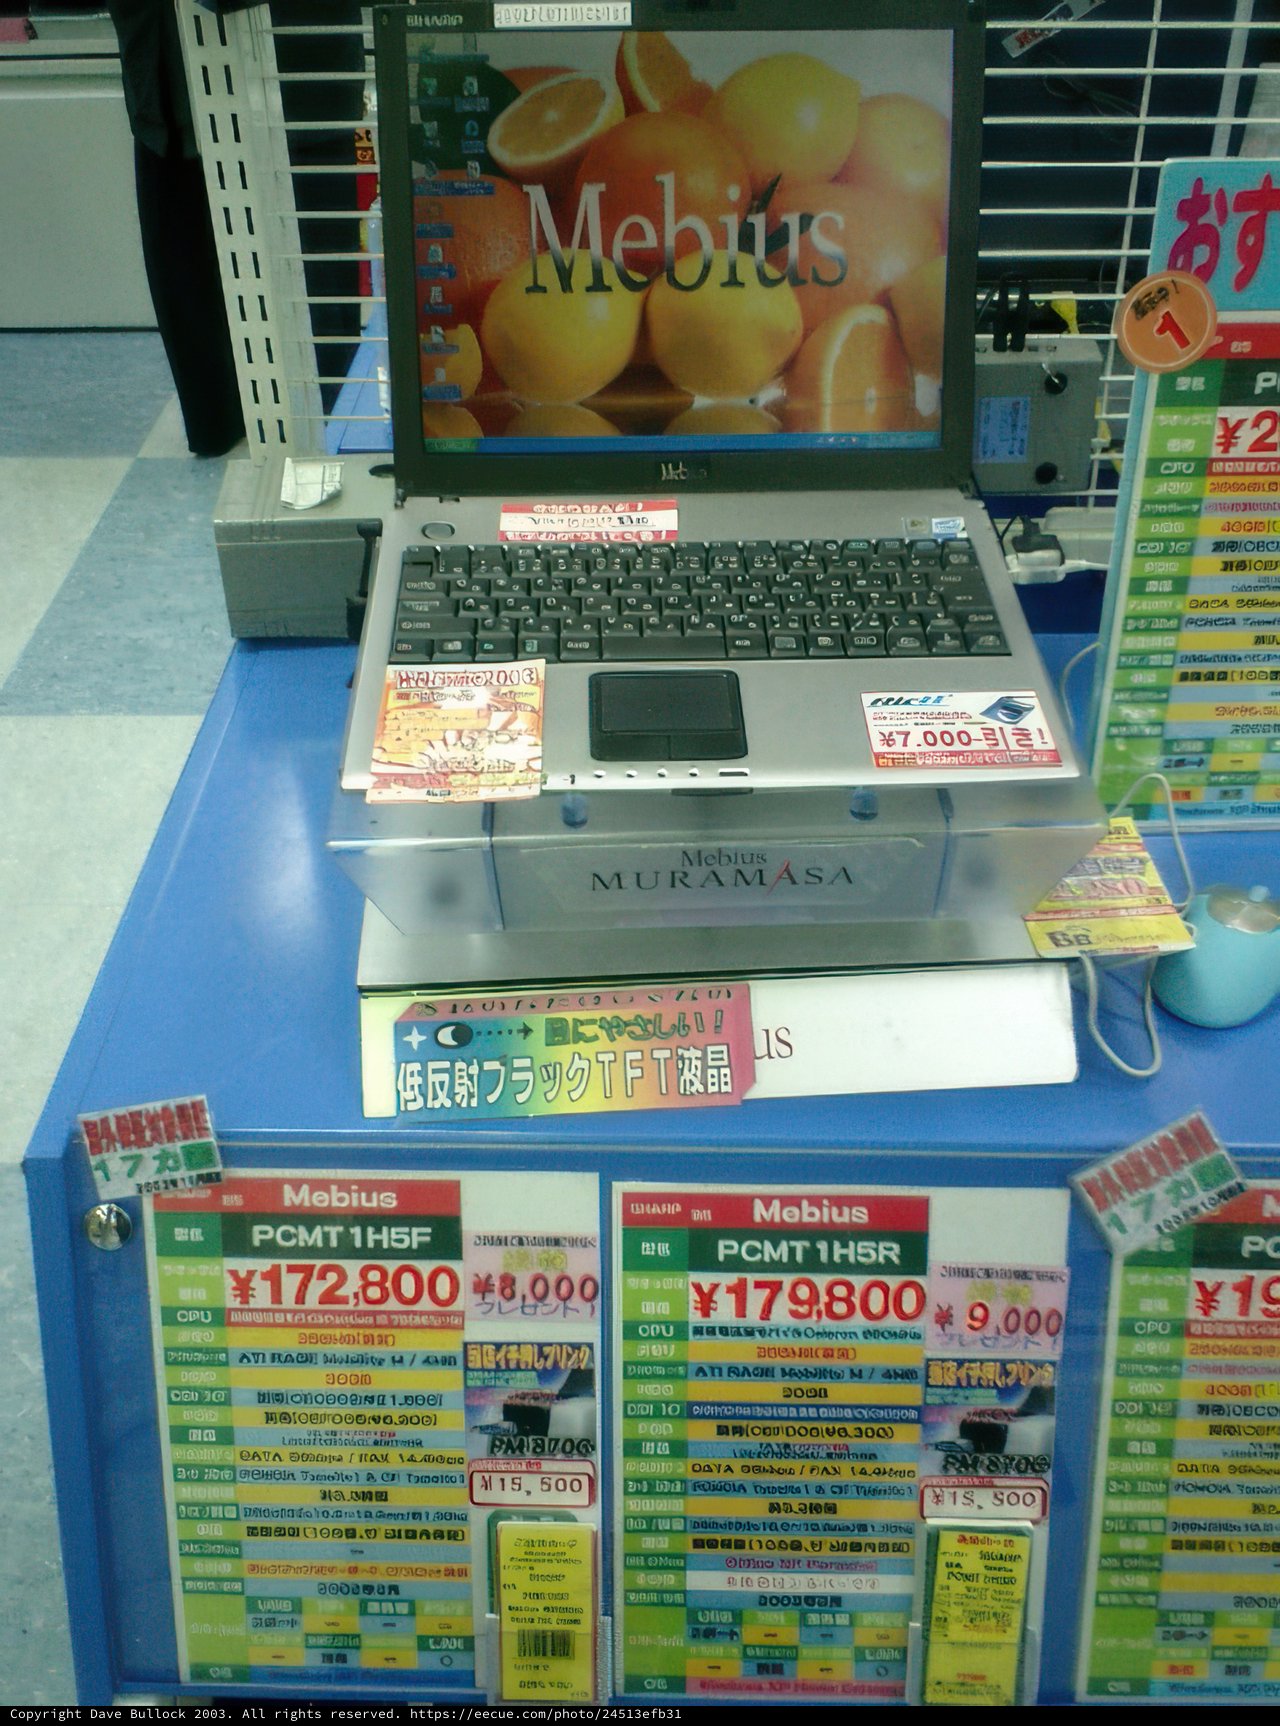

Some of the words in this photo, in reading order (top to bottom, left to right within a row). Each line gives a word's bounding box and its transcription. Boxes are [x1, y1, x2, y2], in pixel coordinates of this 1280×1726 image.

[523, 172, 848, 295] Mebius
[1154, 310, 1191, 350] 1
[681, 849, 768, 868] Mebius
[591, 861, 854, 893] MURAMASA
[283, 1184, 399, 1209] Mebius
[752, 1198, 869, 1223] Mebius
[227, 1263, 459, 1308] ¥172,800
[473, 1272, 599, 1303] ¥8,000
[691, 1276, 926, 1323] ¥179,800
